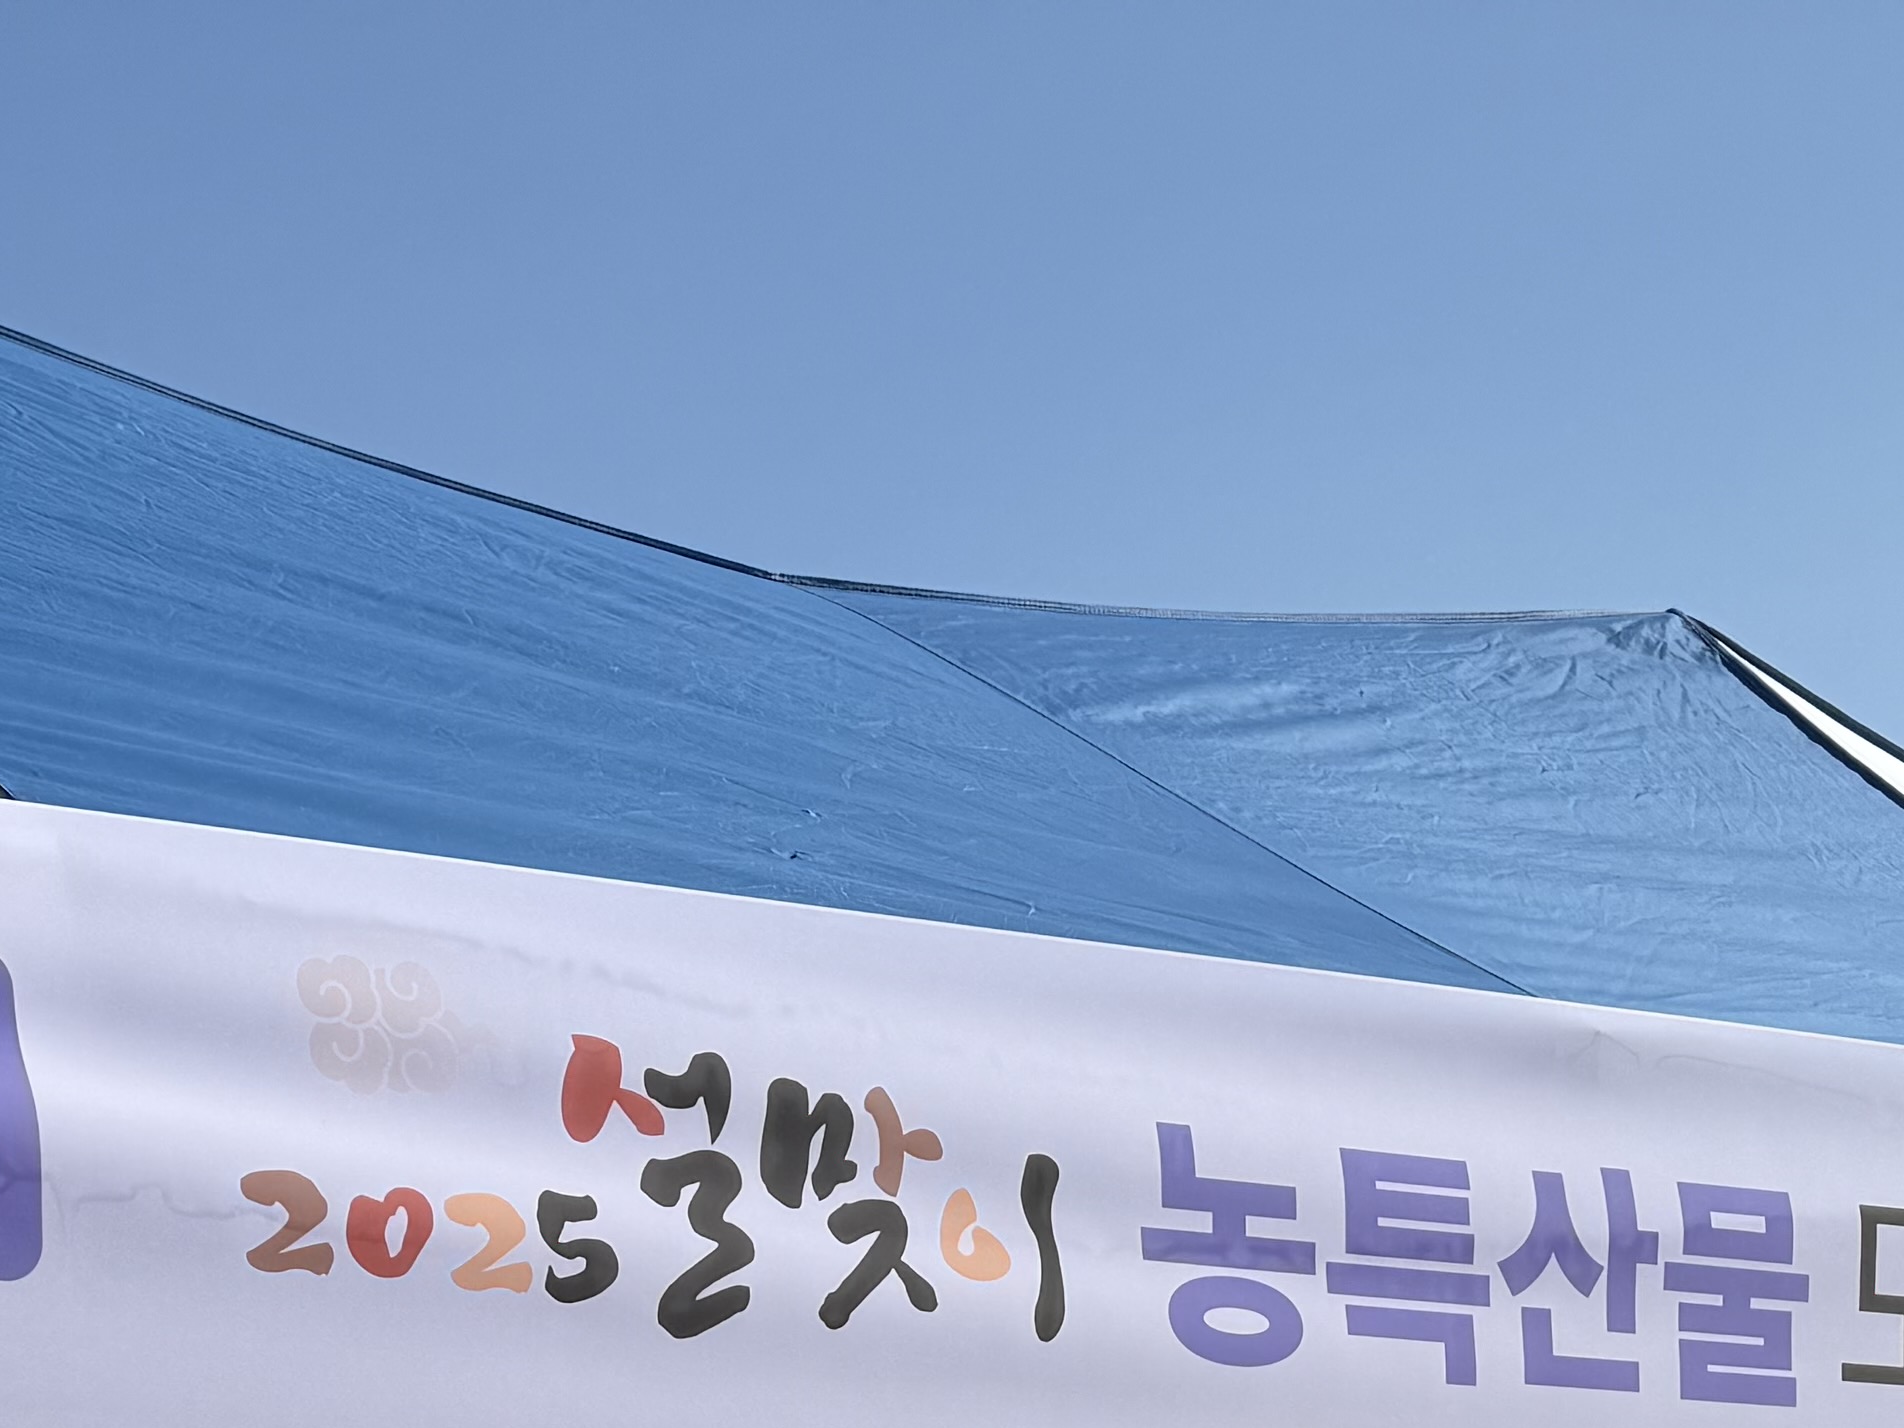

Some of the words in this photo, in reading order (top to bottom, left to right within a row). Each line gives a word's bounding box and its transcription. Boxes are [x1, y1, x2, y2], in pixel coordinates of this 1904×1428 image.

[238, 1168, 620, 1304] 2025
[560, 1032, 1066, 1342] 설맞이
[1138, 1120, 1811, 1408] 농특산물
